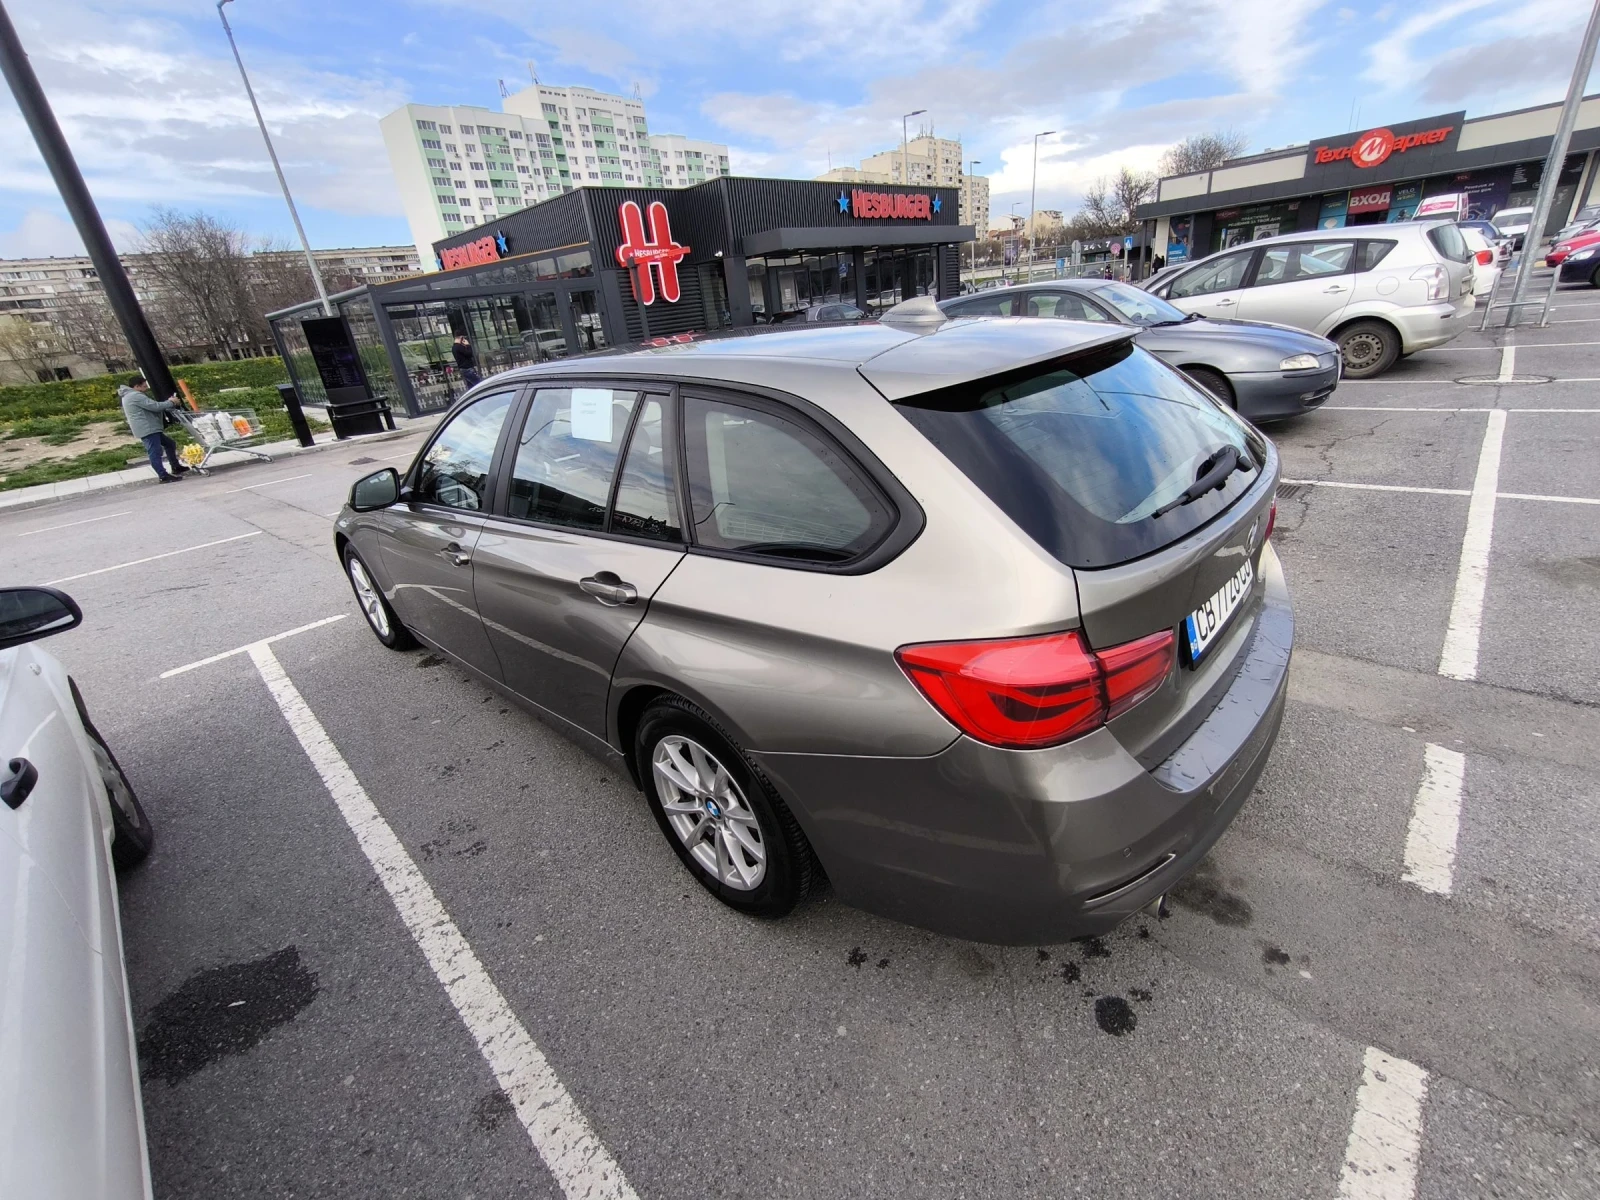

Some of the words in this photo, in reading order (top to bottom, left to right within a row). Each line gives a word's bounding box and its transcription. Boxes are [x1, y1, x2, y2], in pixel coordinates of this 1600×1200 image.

[851, 188, 931, 221] HESBURGER
[1350, 192, 1391, 207] ВХОД
[440, 235, 501, 270] HESBURGER
